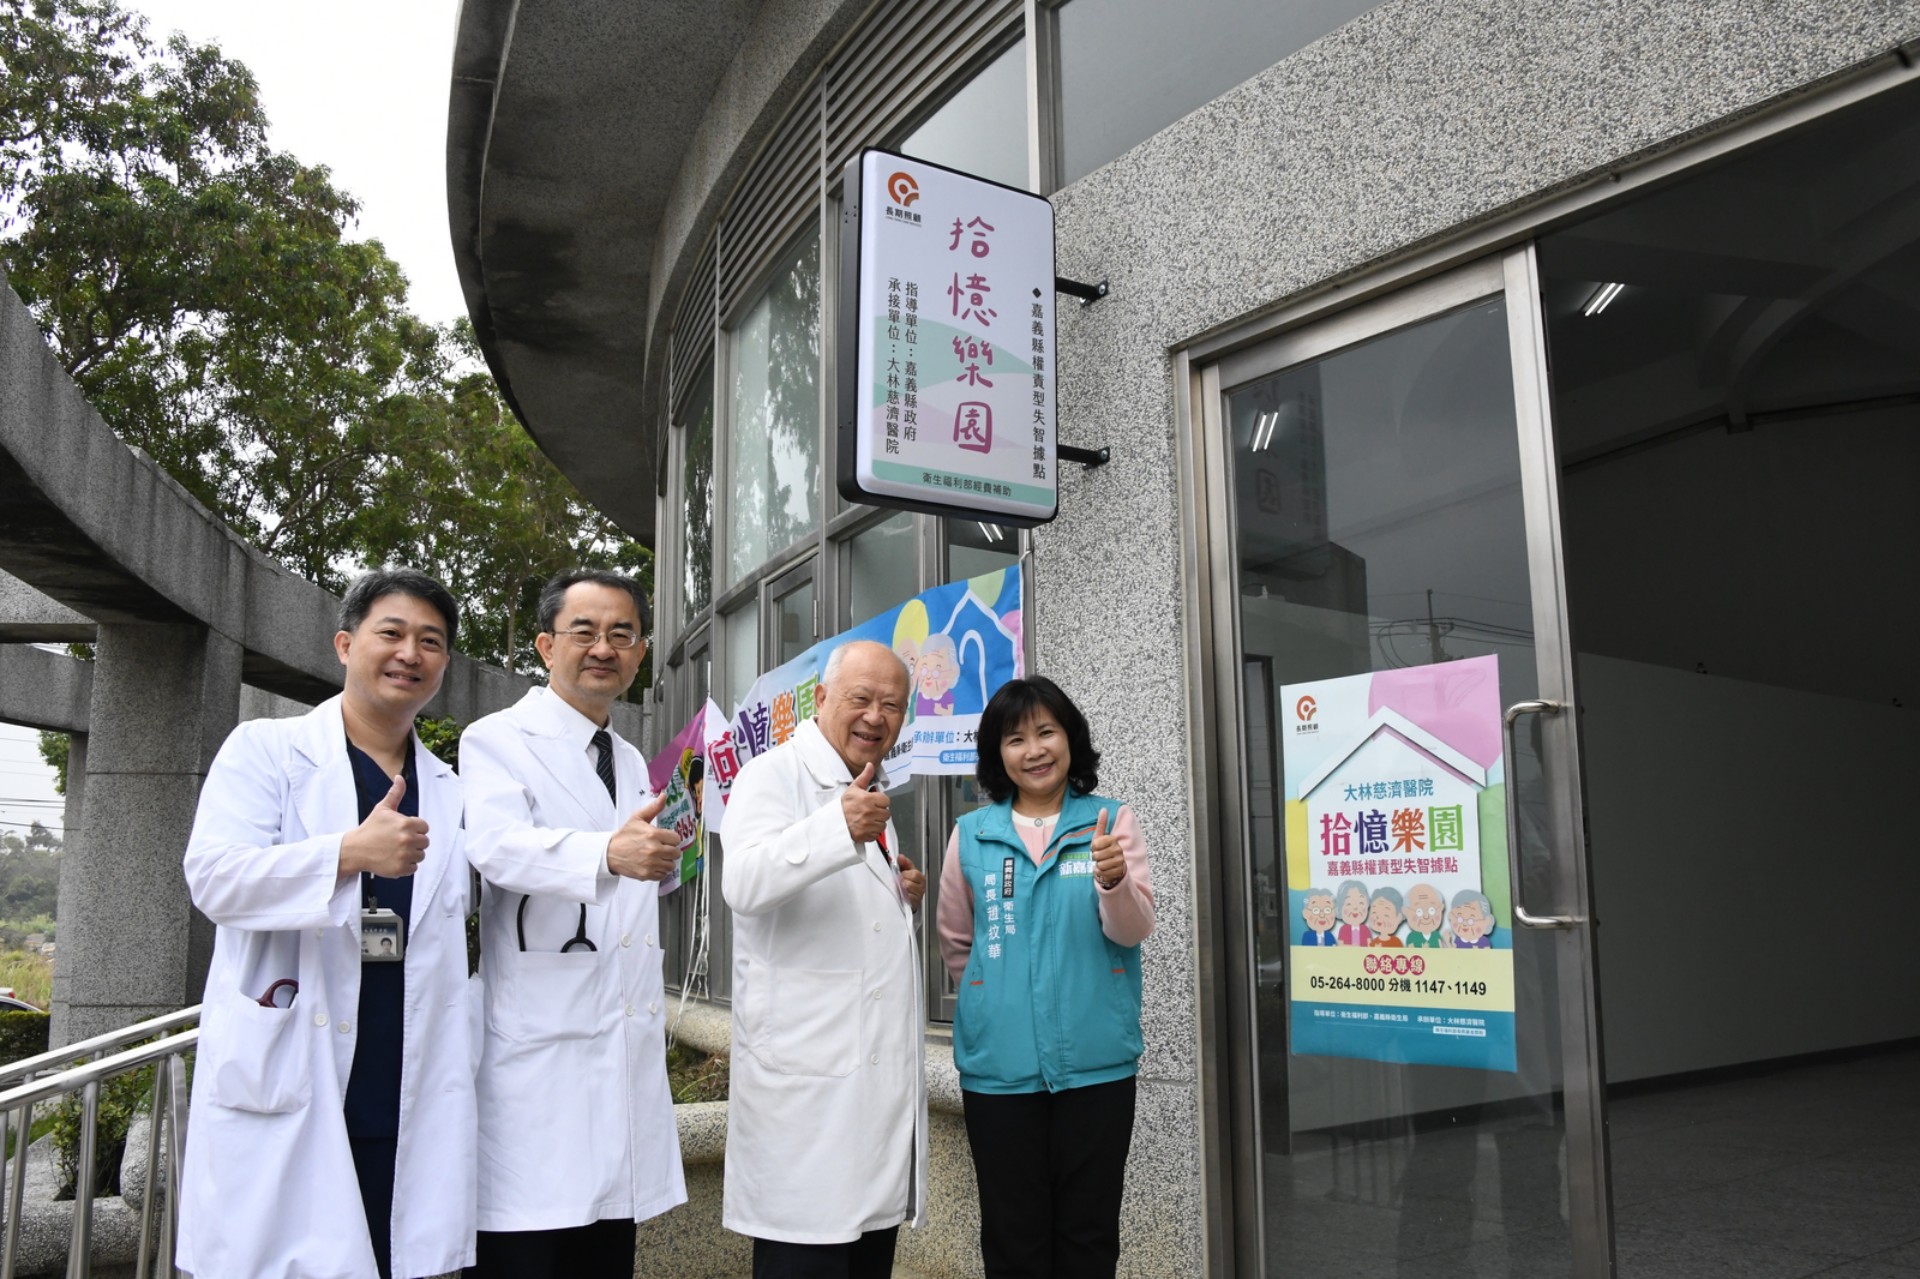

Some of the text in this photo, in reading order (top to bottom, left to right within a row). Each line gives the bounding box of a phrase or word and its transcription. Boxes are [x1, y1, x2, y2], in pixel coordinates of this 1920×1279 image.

[885, 206, 922, 223] 長期照顧
[947, 216, 998, 455] 拾憶樂園
[886, 277, 901, 455] 承接單位：大林慈濟醫院
[903, 281, 919, 442] 指導單位：嘉義縣政府
[1031, 303, 1046, 480] 嘉義縣權責型失智據點
[922, 472, 1012, 497] 衛生福利部經費補助
[1343, 777, 1434, 802] 大林慈濟醫院
[1320, 804, 1464, 856] 拾憶樂園
[1327, 856, 1458, 876] 嘉義縣權責型失智據點
[1003, 901, 1016, 935] 衛生局
[1364, 954, 1425, 975] 聯絡專線
[1310, 976, 1385, 992] 05-264-8000
[1388, 978, 1411, 992] 分機
